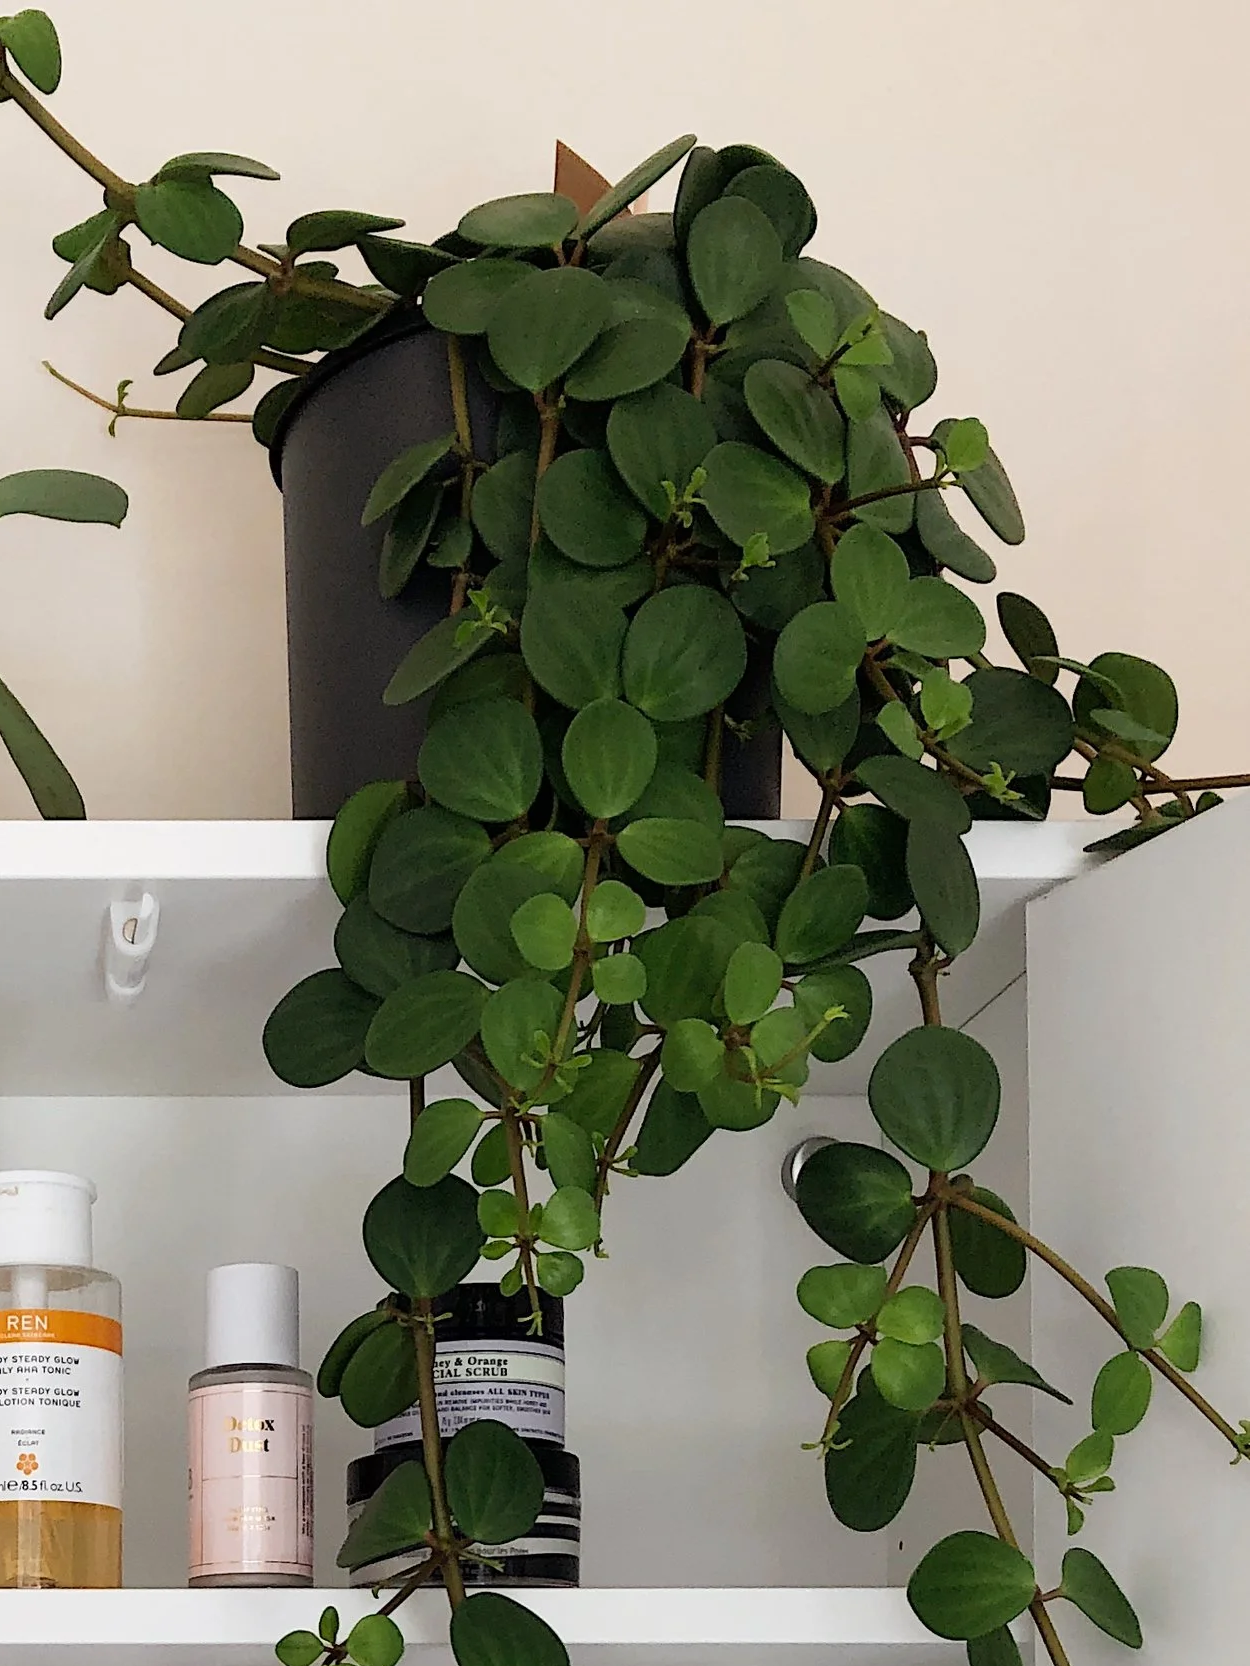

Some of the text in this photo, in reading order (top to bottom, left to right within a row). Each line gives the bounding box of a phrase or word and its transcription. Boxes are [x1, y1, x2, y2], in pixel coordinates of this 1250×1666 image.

[7, 1315, 48, 1330] REN
[54, 1356, 79, 1364] GLOW
[433, 1356, 508, 1370] ney & Orange
[42, 1366, 71, 1375] TONIC
[433, 1368, 507, 1379] CIAL SCRUB
[54, 1388, 79, 1396] GLOW
[0, 1398, 34, 1407] LOTION
[39, 1399, 80, 1408] TONIQUE
[225, 1416, 274, 1431] Detox
[229, 1437, 269, 1452] Dust
